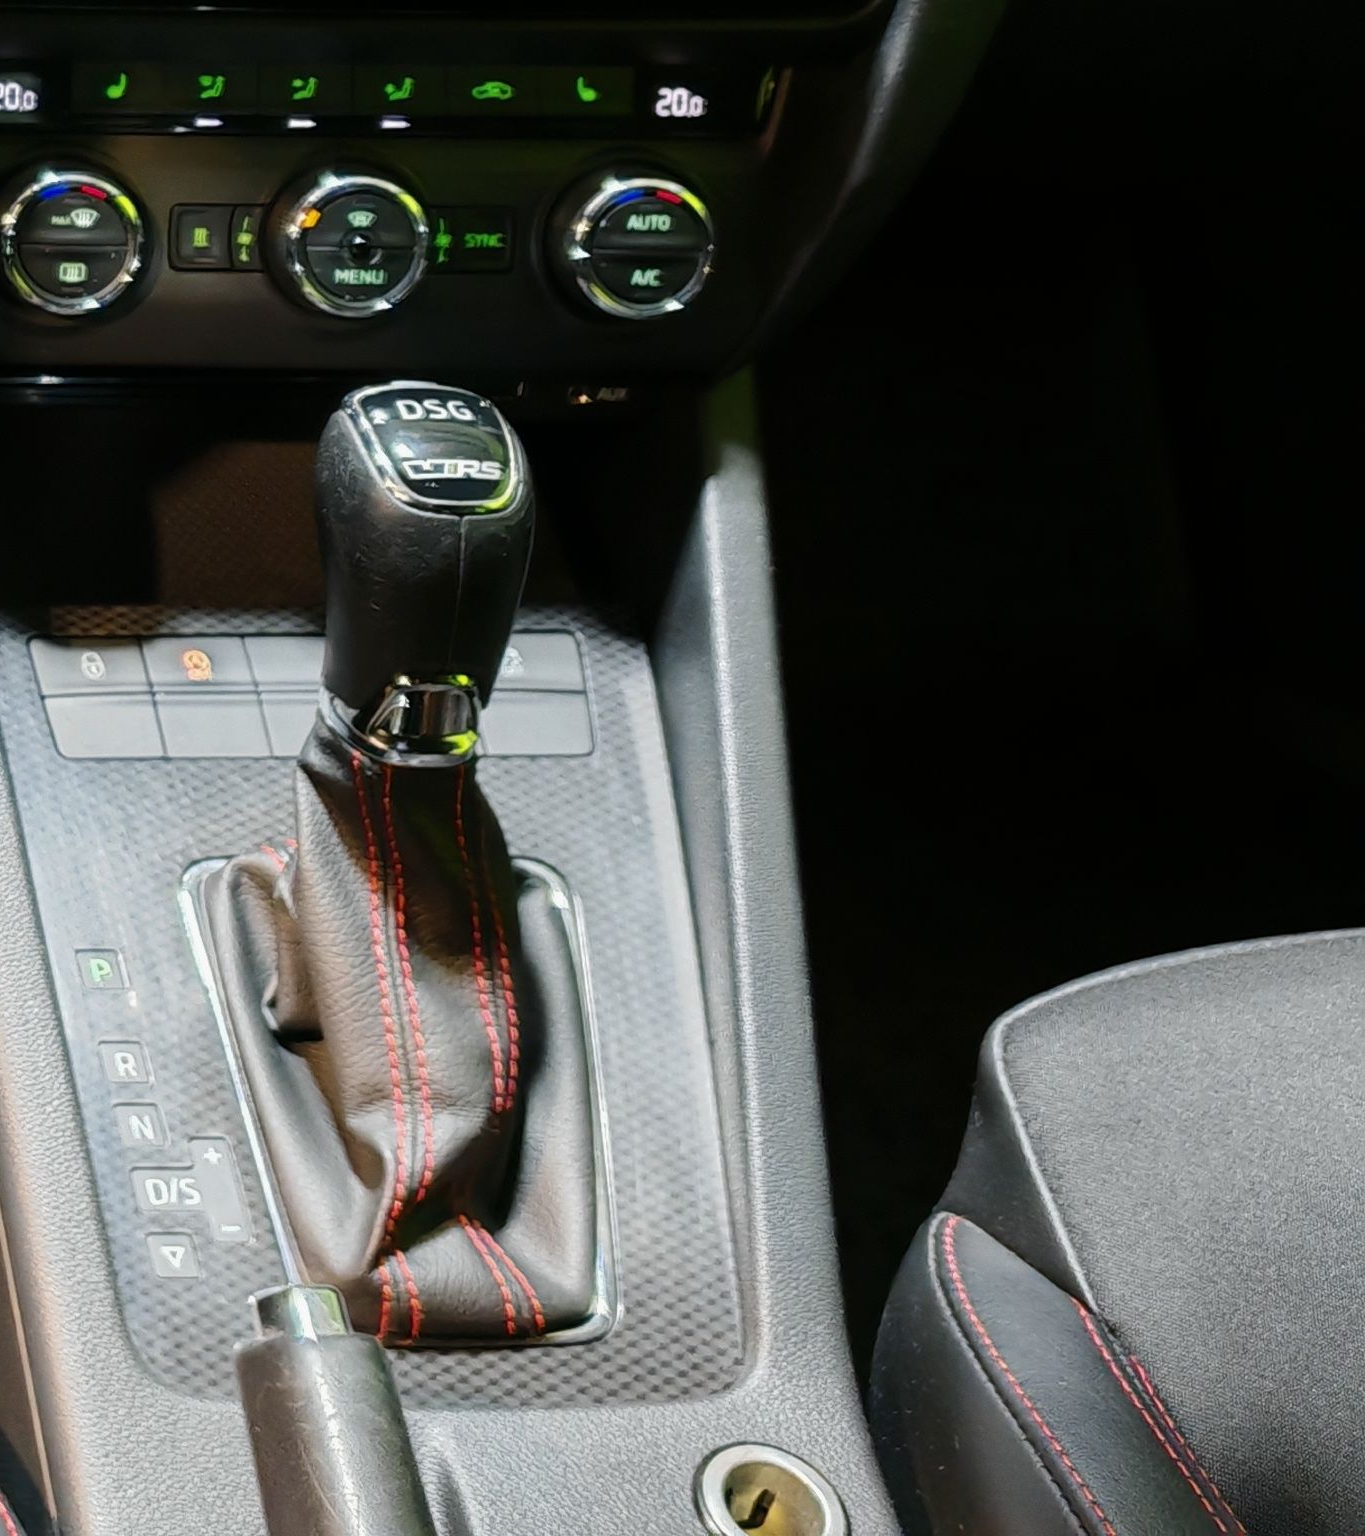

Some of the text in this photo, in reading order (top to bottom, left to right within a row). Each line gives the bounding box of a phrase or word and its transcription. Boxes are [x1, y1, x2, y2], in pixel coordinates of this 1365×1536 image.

[626, 214, 671, 232] AUTO
[334, 269, 388, 285] MENU
[630, 270, 663, 286] A/C
[396, 399, 476, 420] DSG
[90, 959, 112, 983] P
[114, 1052, 138, 1077] R
[129, 1114, 155, 1140] N
[145, 1177, 201, 1206] D/S
